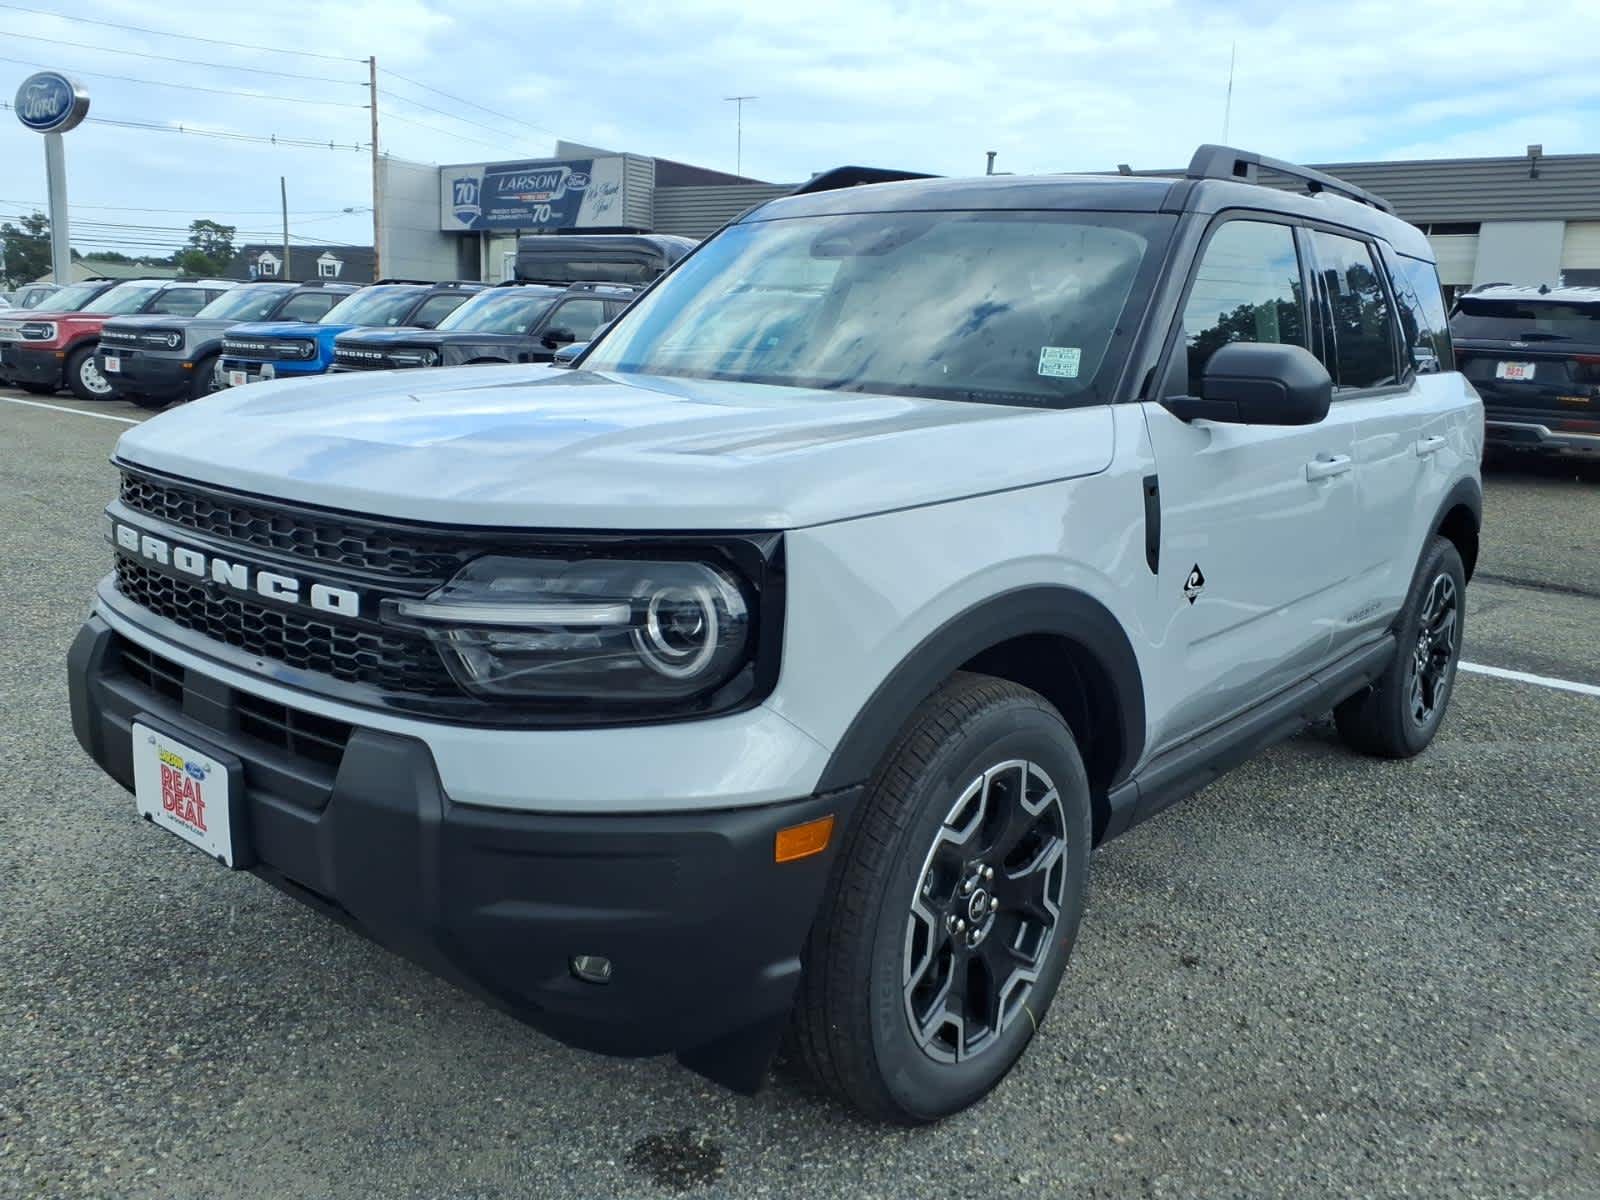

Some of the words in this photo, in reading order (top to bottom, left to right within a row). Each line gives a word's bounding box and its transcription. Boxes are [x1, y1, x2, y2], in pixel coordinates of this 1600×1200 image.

[24, 83, 59, 119] Ford
[455, 183, 475, 204] 70
[497, 174, 559, 192] LARSON
[532, 204, 552, 223] 70
[335, 350, 382, 359] BRONCO
[117, 524, 360, 618] BRONCO
[161, 763, 206, 808] REAL
[162, 786, 208, 832] DEAL
